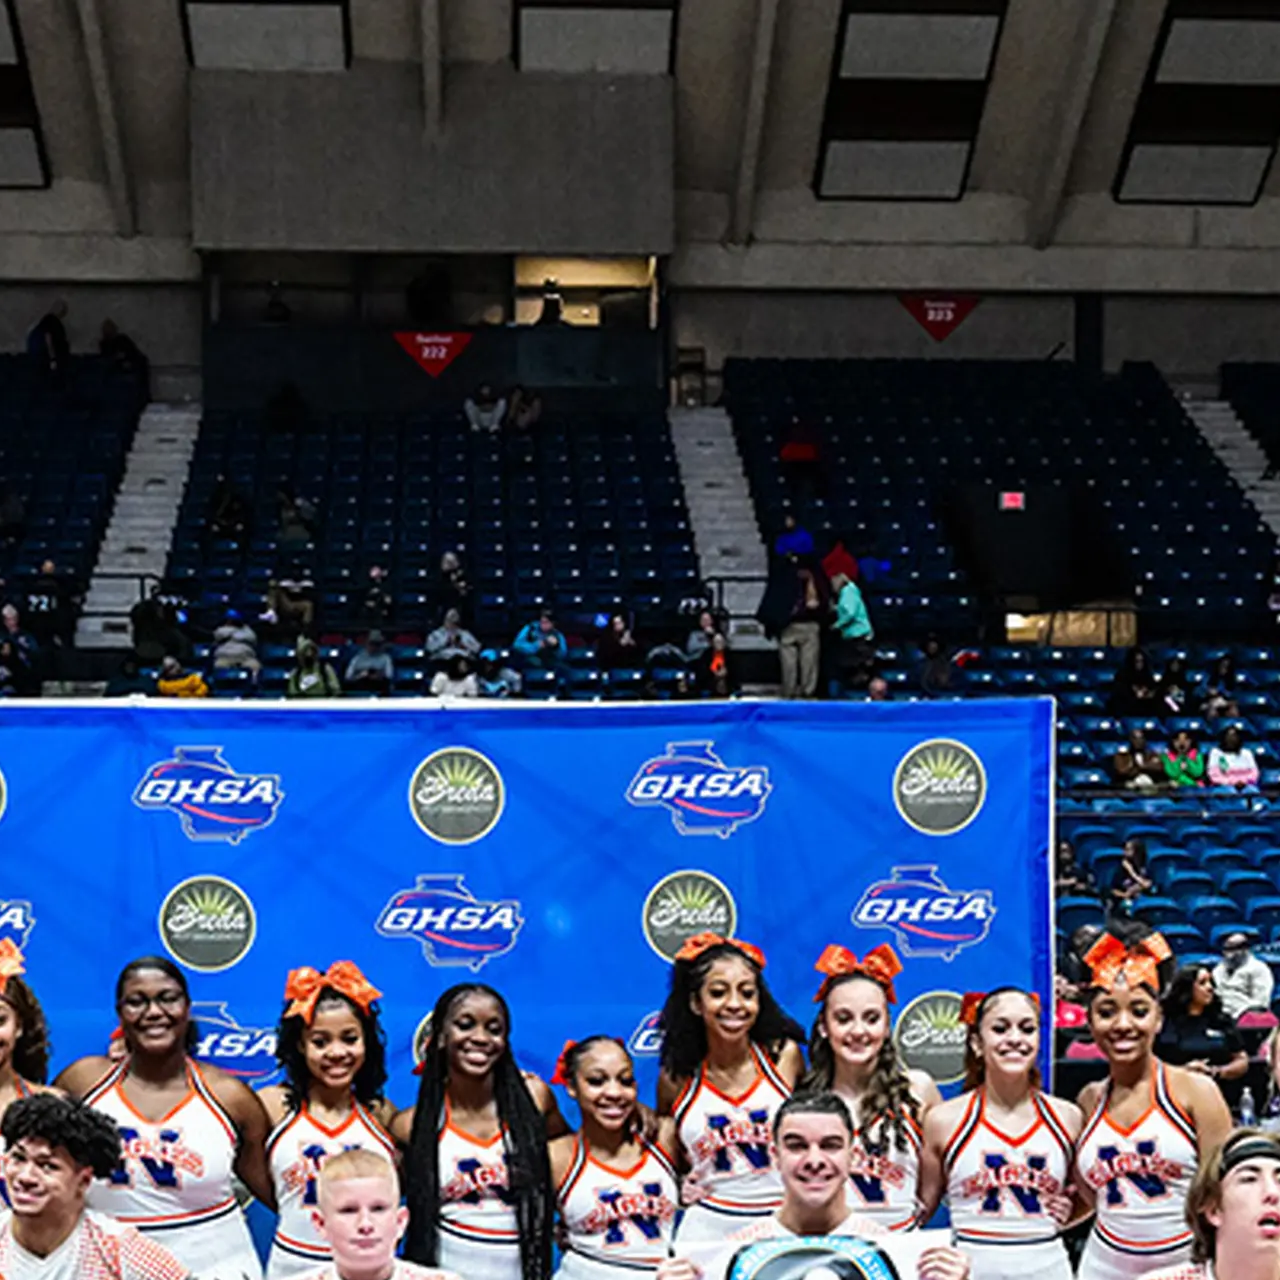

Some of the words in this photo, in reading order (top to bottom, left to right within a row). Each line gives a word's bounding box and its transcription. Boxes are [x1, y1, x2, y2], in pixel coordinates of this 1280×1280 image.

[138, 778, 276, 804] GHSA
[414, 774, 495, 804] Breda
[632, 773, 763, 799] GHSA
[899, 763, 977, 794] Breda
[166, 901, 246, 932] Breda
[381, 906, 517, 932] GHSA
[648, 893, 727, 926] Breda
[857, 897, 987, 923] GHSA
[981, 1152, 1045, 1217] N
[1096, 1138, 1170, 1206] N
